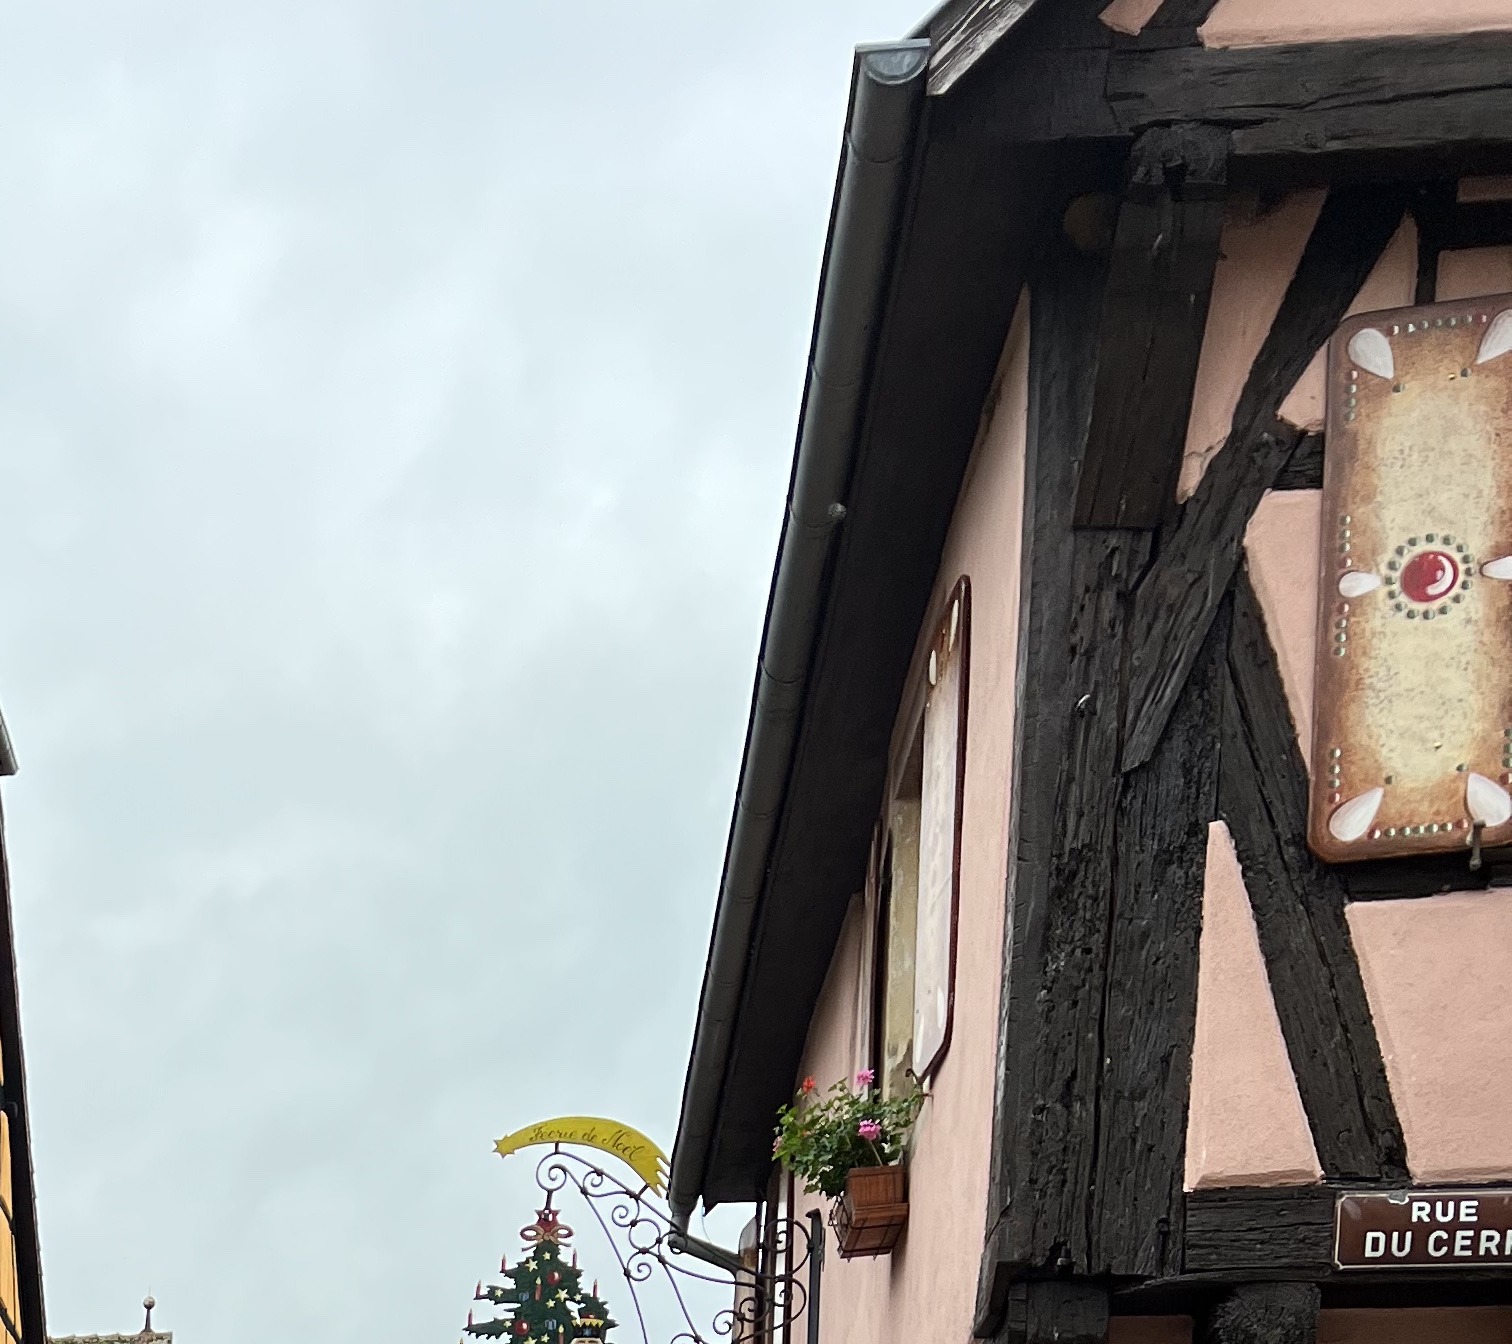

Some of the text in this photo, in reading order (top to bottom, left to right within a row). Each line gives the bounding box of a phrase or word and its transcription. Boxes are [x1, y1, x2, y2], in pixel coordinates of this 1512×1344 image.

[581, 1127, 597, 1143] de
[1411, 1200, 1479, 1222] RUE
[1364, 1230, 1412, 1258] DU
